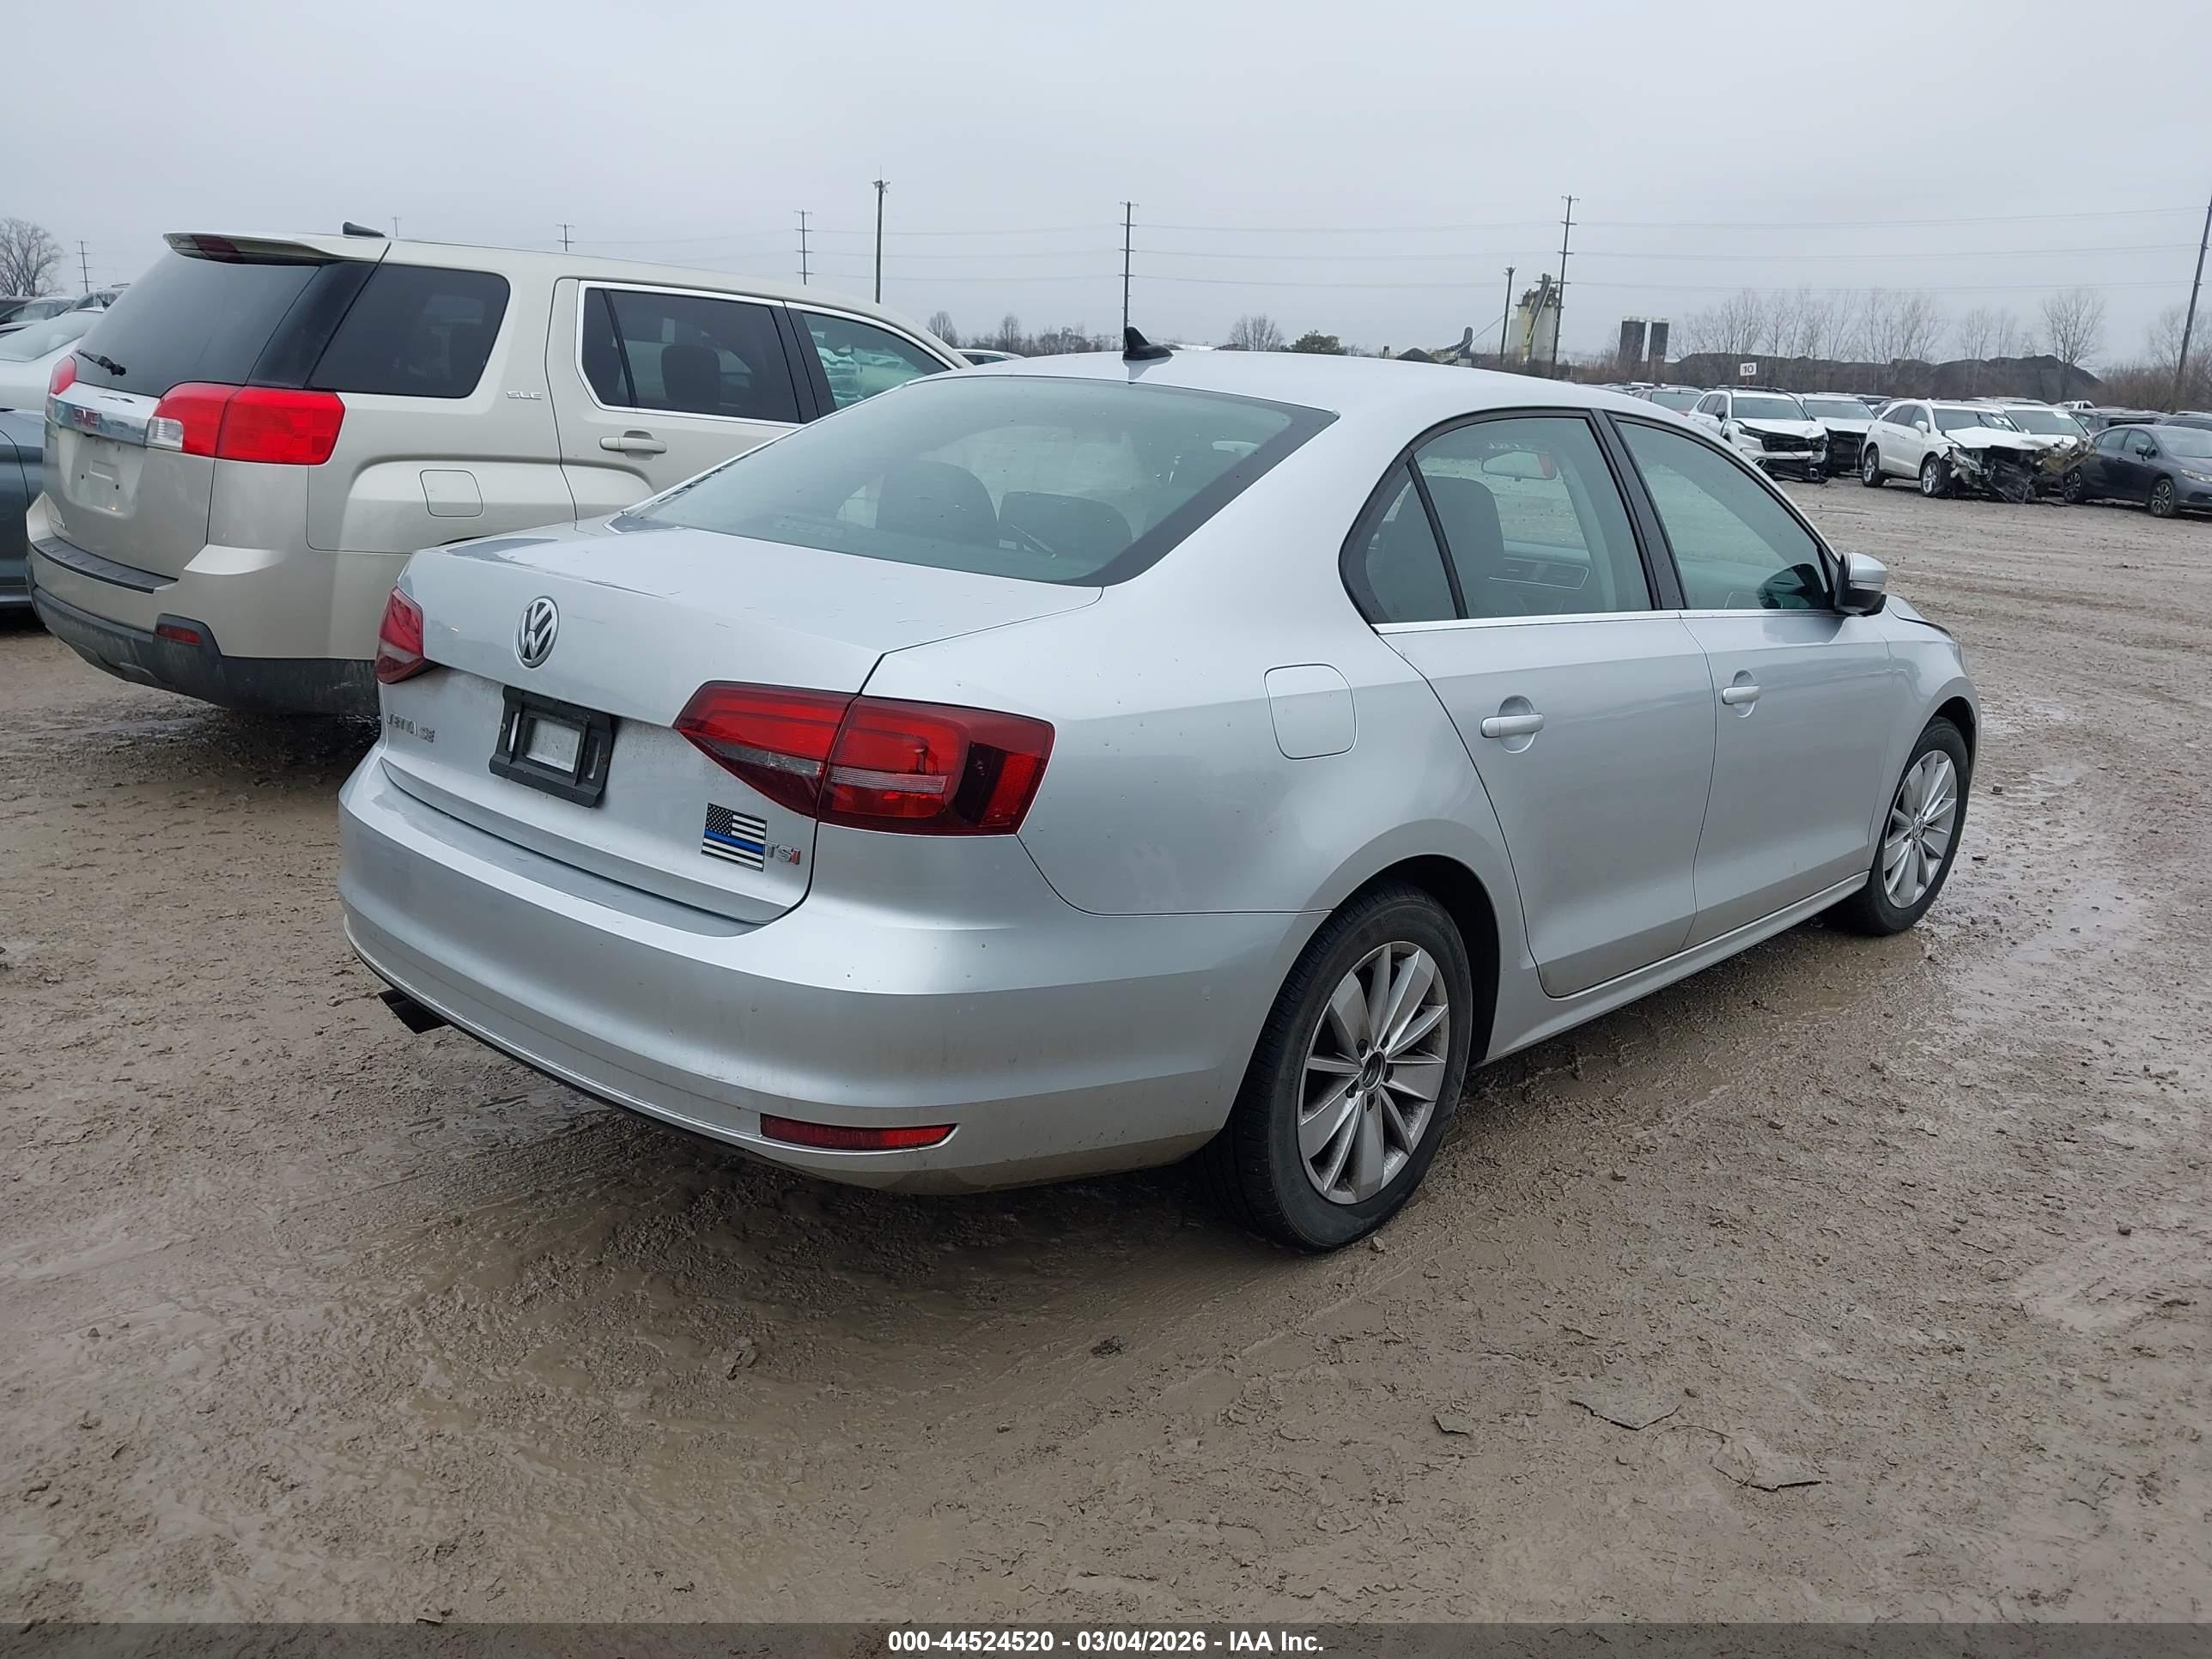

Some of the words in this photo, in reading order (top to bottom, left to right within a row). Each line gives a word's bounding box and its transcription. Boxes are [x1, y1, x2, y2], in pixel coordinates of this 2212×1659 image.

[1743, 364, 1754, 374] 10
[507, 391, 543, 400] SLE
[517, 599, 556, 664] VW
